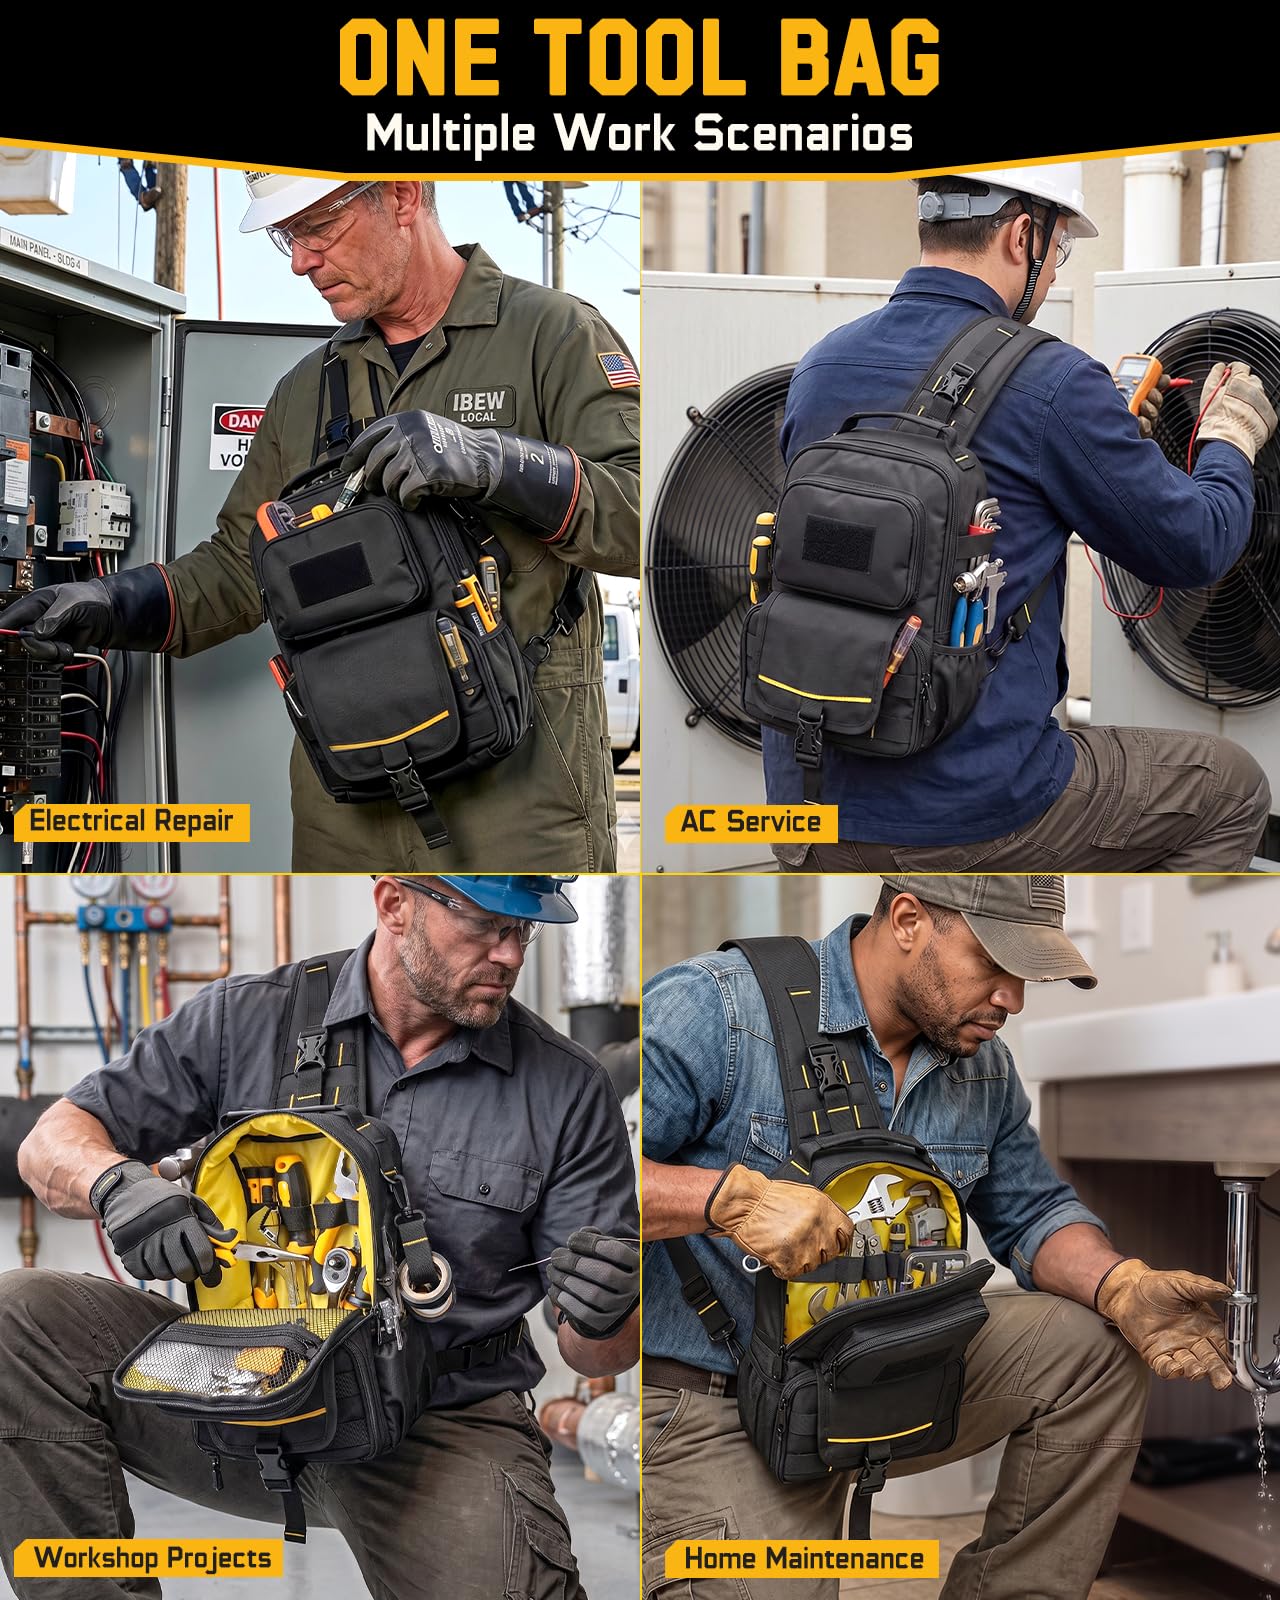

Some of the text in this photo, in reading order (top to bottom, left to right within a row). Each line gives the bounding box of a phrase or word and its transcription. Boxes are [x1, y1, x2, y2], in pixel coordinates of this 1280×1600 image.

[9, 234, 28, 252] MAIN
[453, 390, 506, 412] IBEW
[228, 413, 264, 429] DAN
[460, 412, 497, 423] LOCAL
[530, 452, 545, 466] 2
